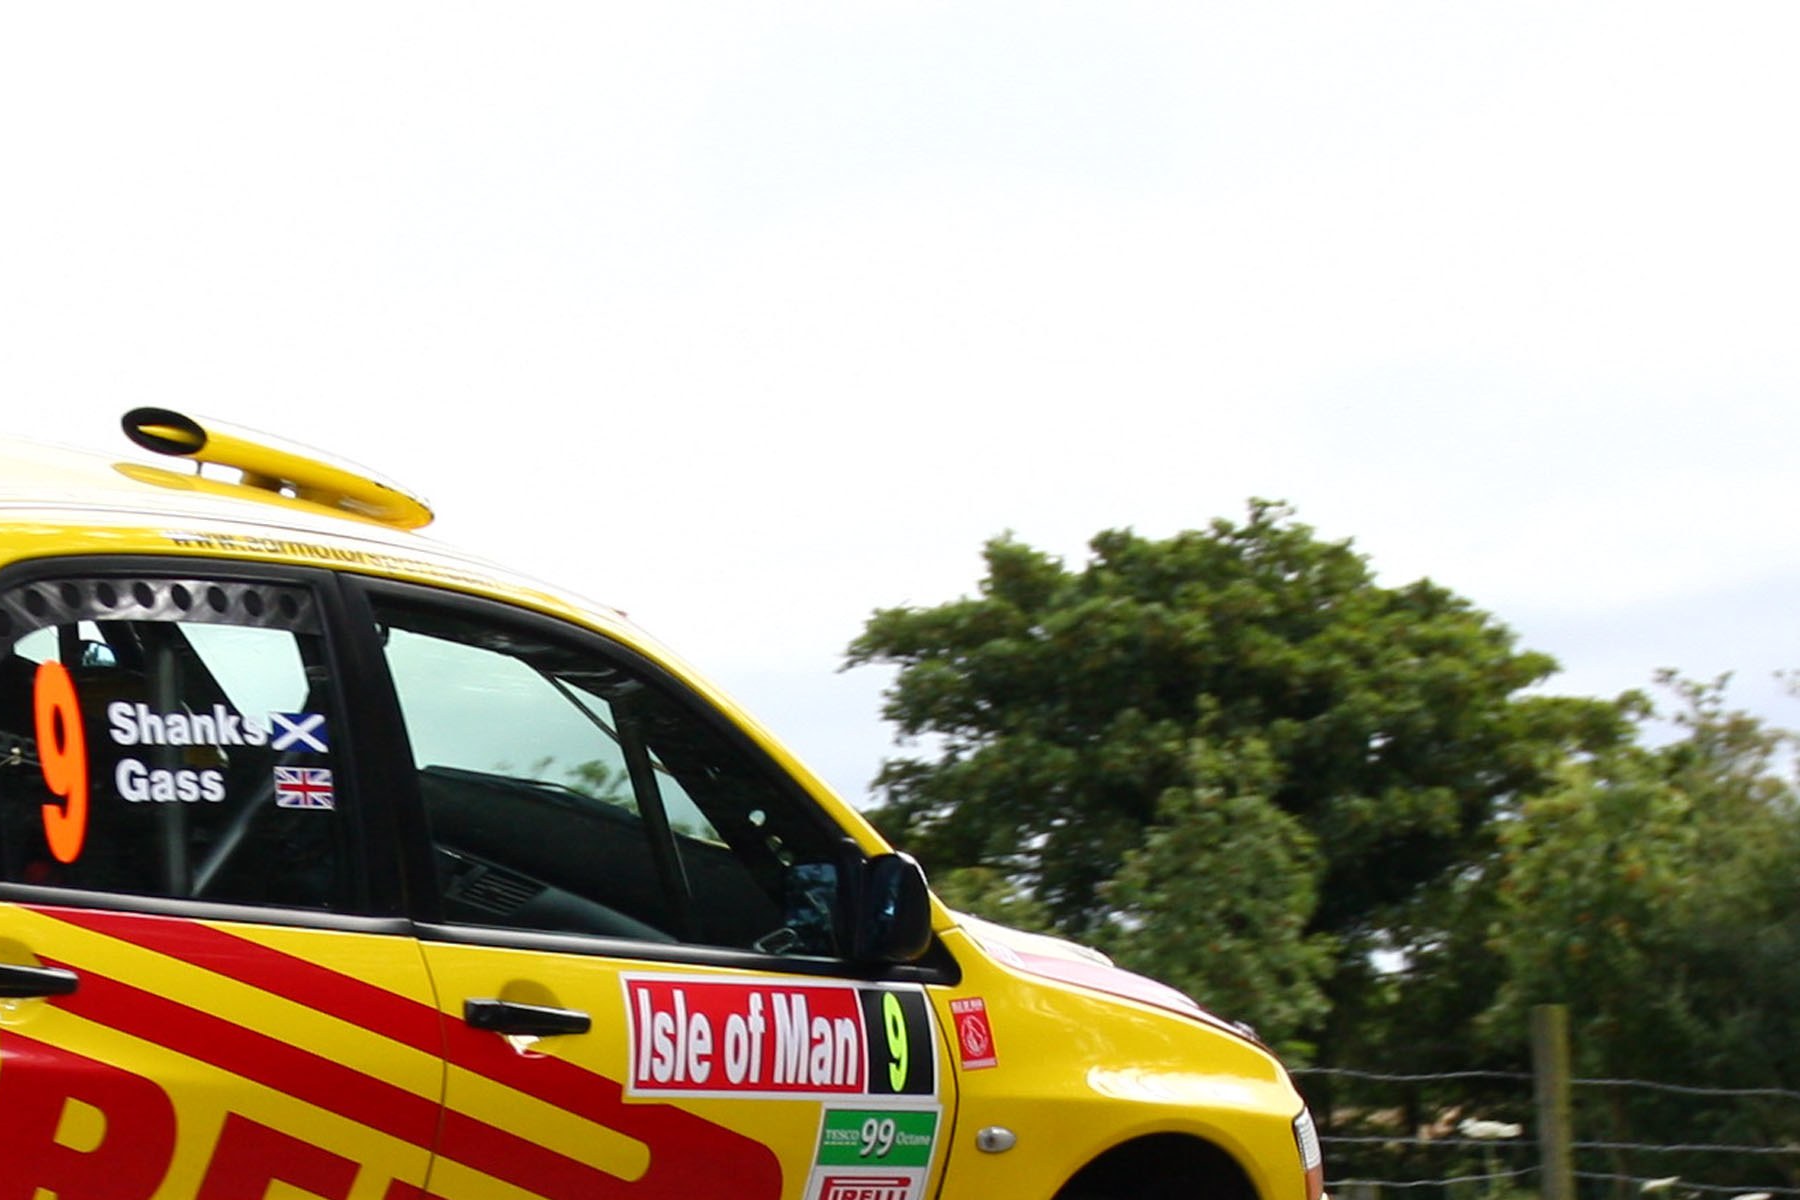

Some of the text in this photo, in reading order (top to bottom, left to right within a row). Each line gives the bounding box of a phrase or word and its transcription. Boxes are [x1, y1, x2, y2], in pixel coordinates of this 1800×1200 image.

[107, 700, 271, 748] Shanks
[34, 659, 88, 864] 9
[115, 758, 226, 803] Gass
[636, 987, 858, 1086] Isle of Man
[881, 991, 909, 1092] 9
[824, 1117, 932, 1158] TESCO 99 Octane
